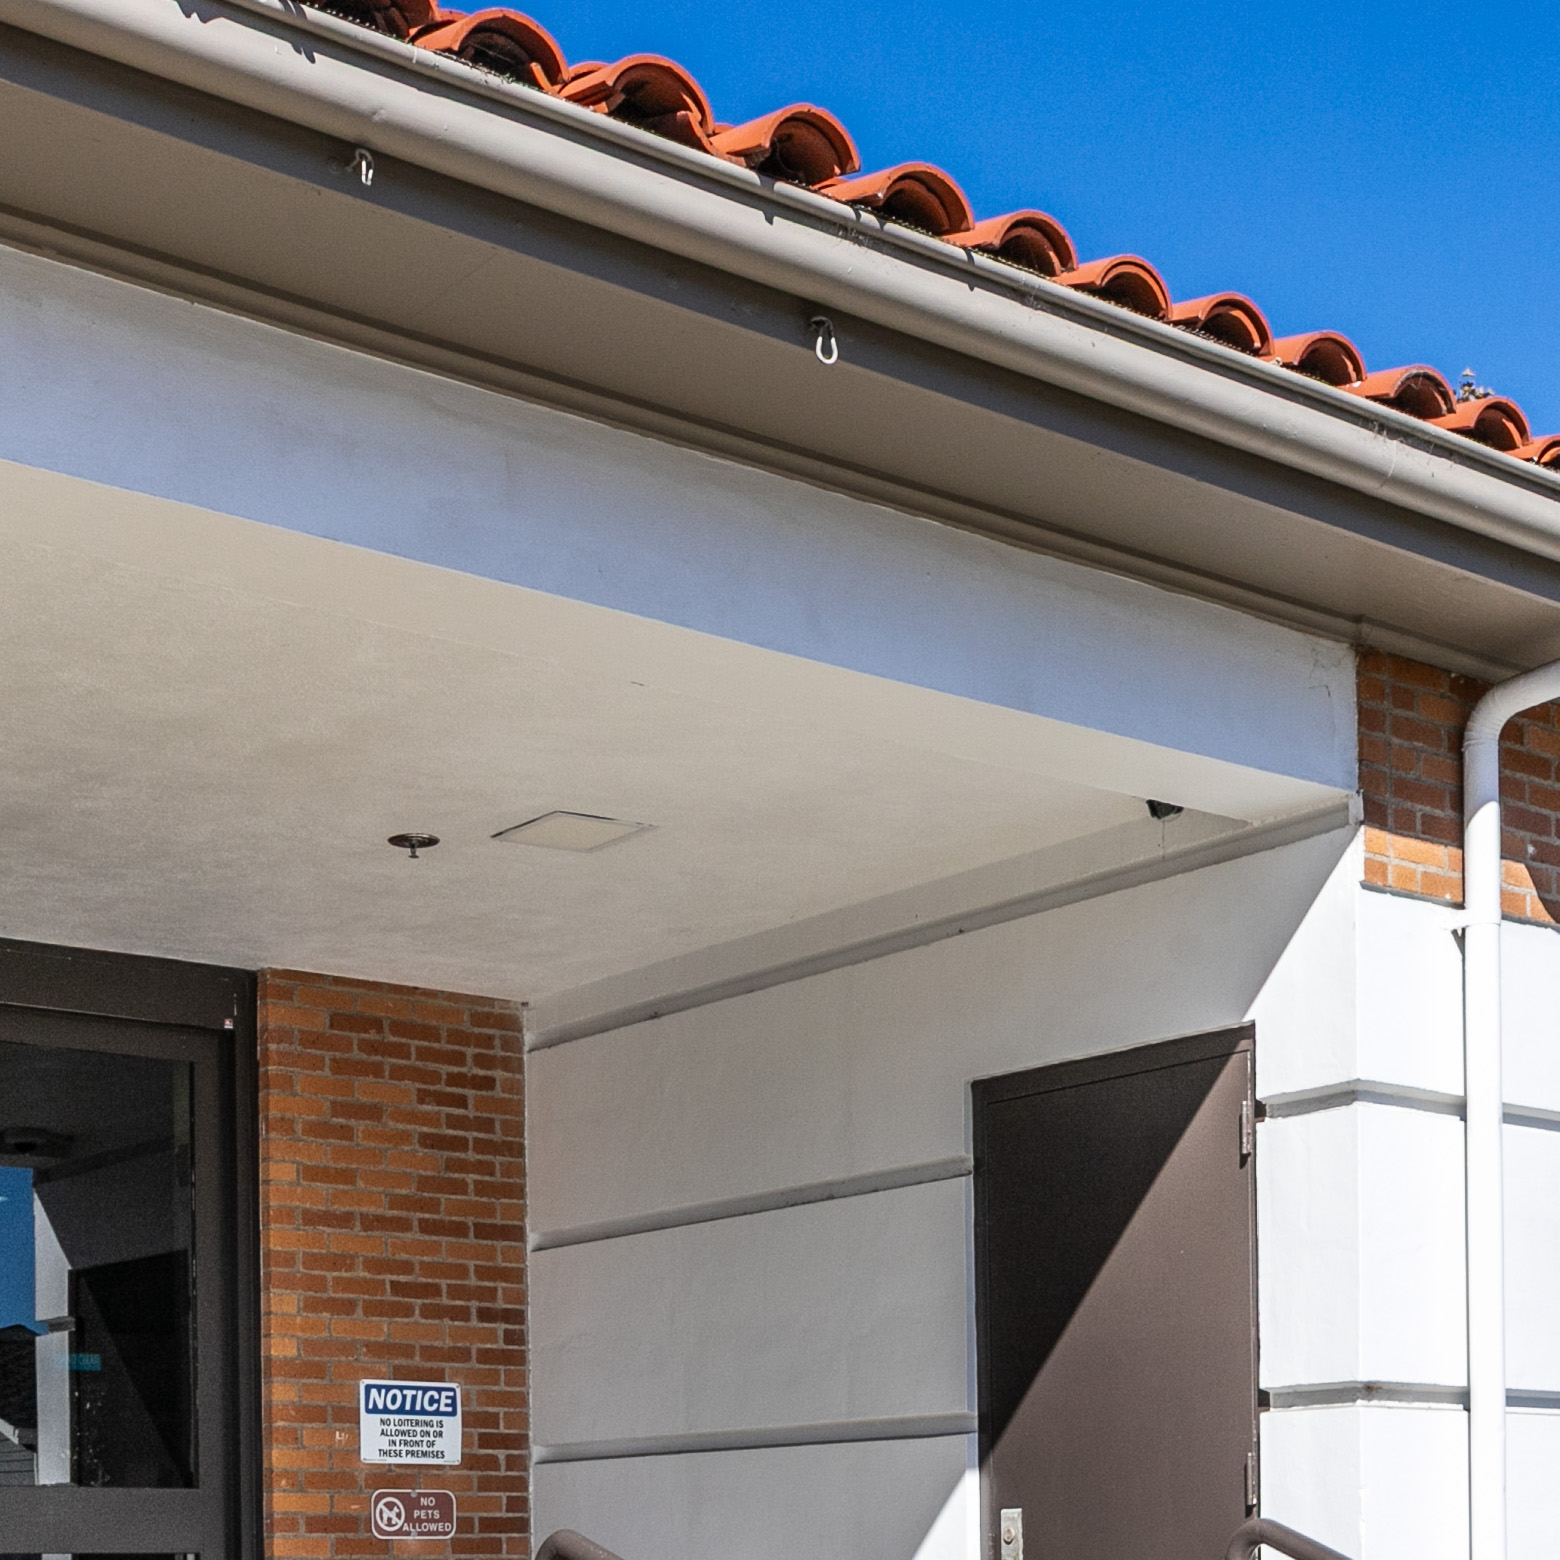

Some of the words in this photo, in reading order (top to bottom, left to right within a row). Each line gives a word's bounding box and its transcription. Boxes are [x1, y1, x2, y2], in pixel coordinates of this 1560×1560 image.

[368, 1388, 454, 1412] NOTICE
[379, 1418, 391, 1427] NO
[393, 1418, 434, 1428] LOITERING
[436, 1419, 444, 1428] IS
[380, 1429, 417, 1438] ALLOWED
[419, 1429, 430, 1438] ON
[433, 1430, 443, 1439] OR
[388, 1439, 397, 1447] IN
[398, 1439, 424, 1448] FRONT
[426, 1439, 436, 1448] OF
[378, 1449, 403, 1458] THESE
[405, 1449, 445, 1459] PREMISES
[420, 1497, 435, 1507] NO
[413, 1509, 440, 1519] PETS
[402, 1522, 452, 1532] ALLOWED
